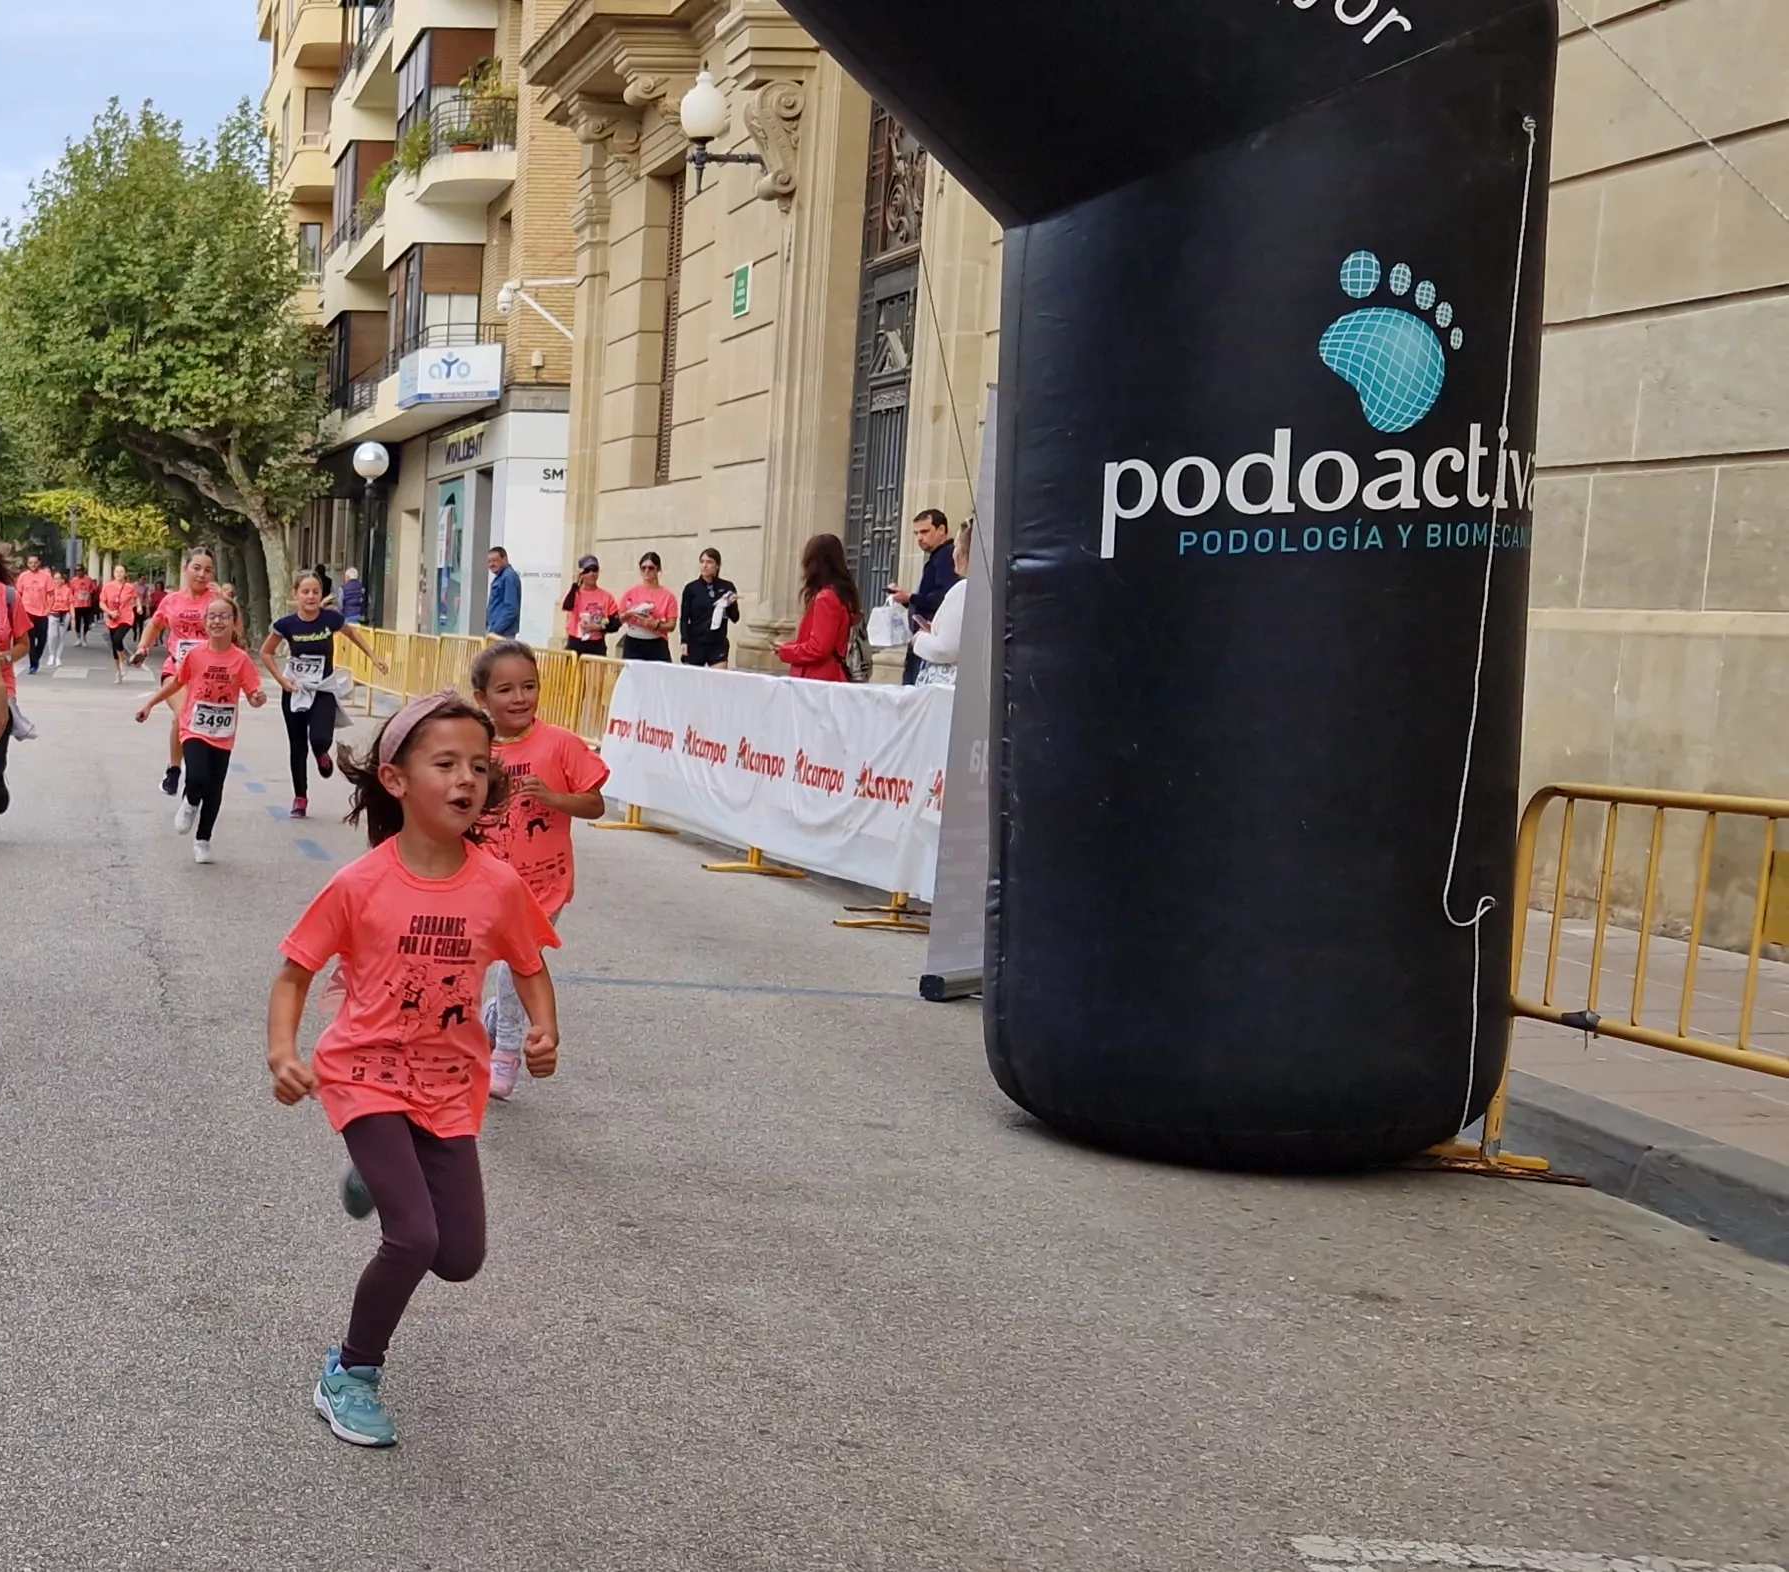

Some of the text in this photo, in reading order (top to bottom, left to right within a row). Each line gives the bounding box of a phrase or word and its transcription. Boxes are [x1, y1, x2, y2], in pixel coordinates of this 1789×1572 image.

[543, 468, 568, 480] SM
[1178, 519, 1383, 556] PODOLOGÍA
[1397, 526, 1414, 548] Y
[196, 713, 231, 727] 3490
[735, 736, 785, 782] Alcampo
[792, 748, 844, 797] Alcampo
[397, 936, 418, 954] POR
[420, 936, 432, 955] LA
